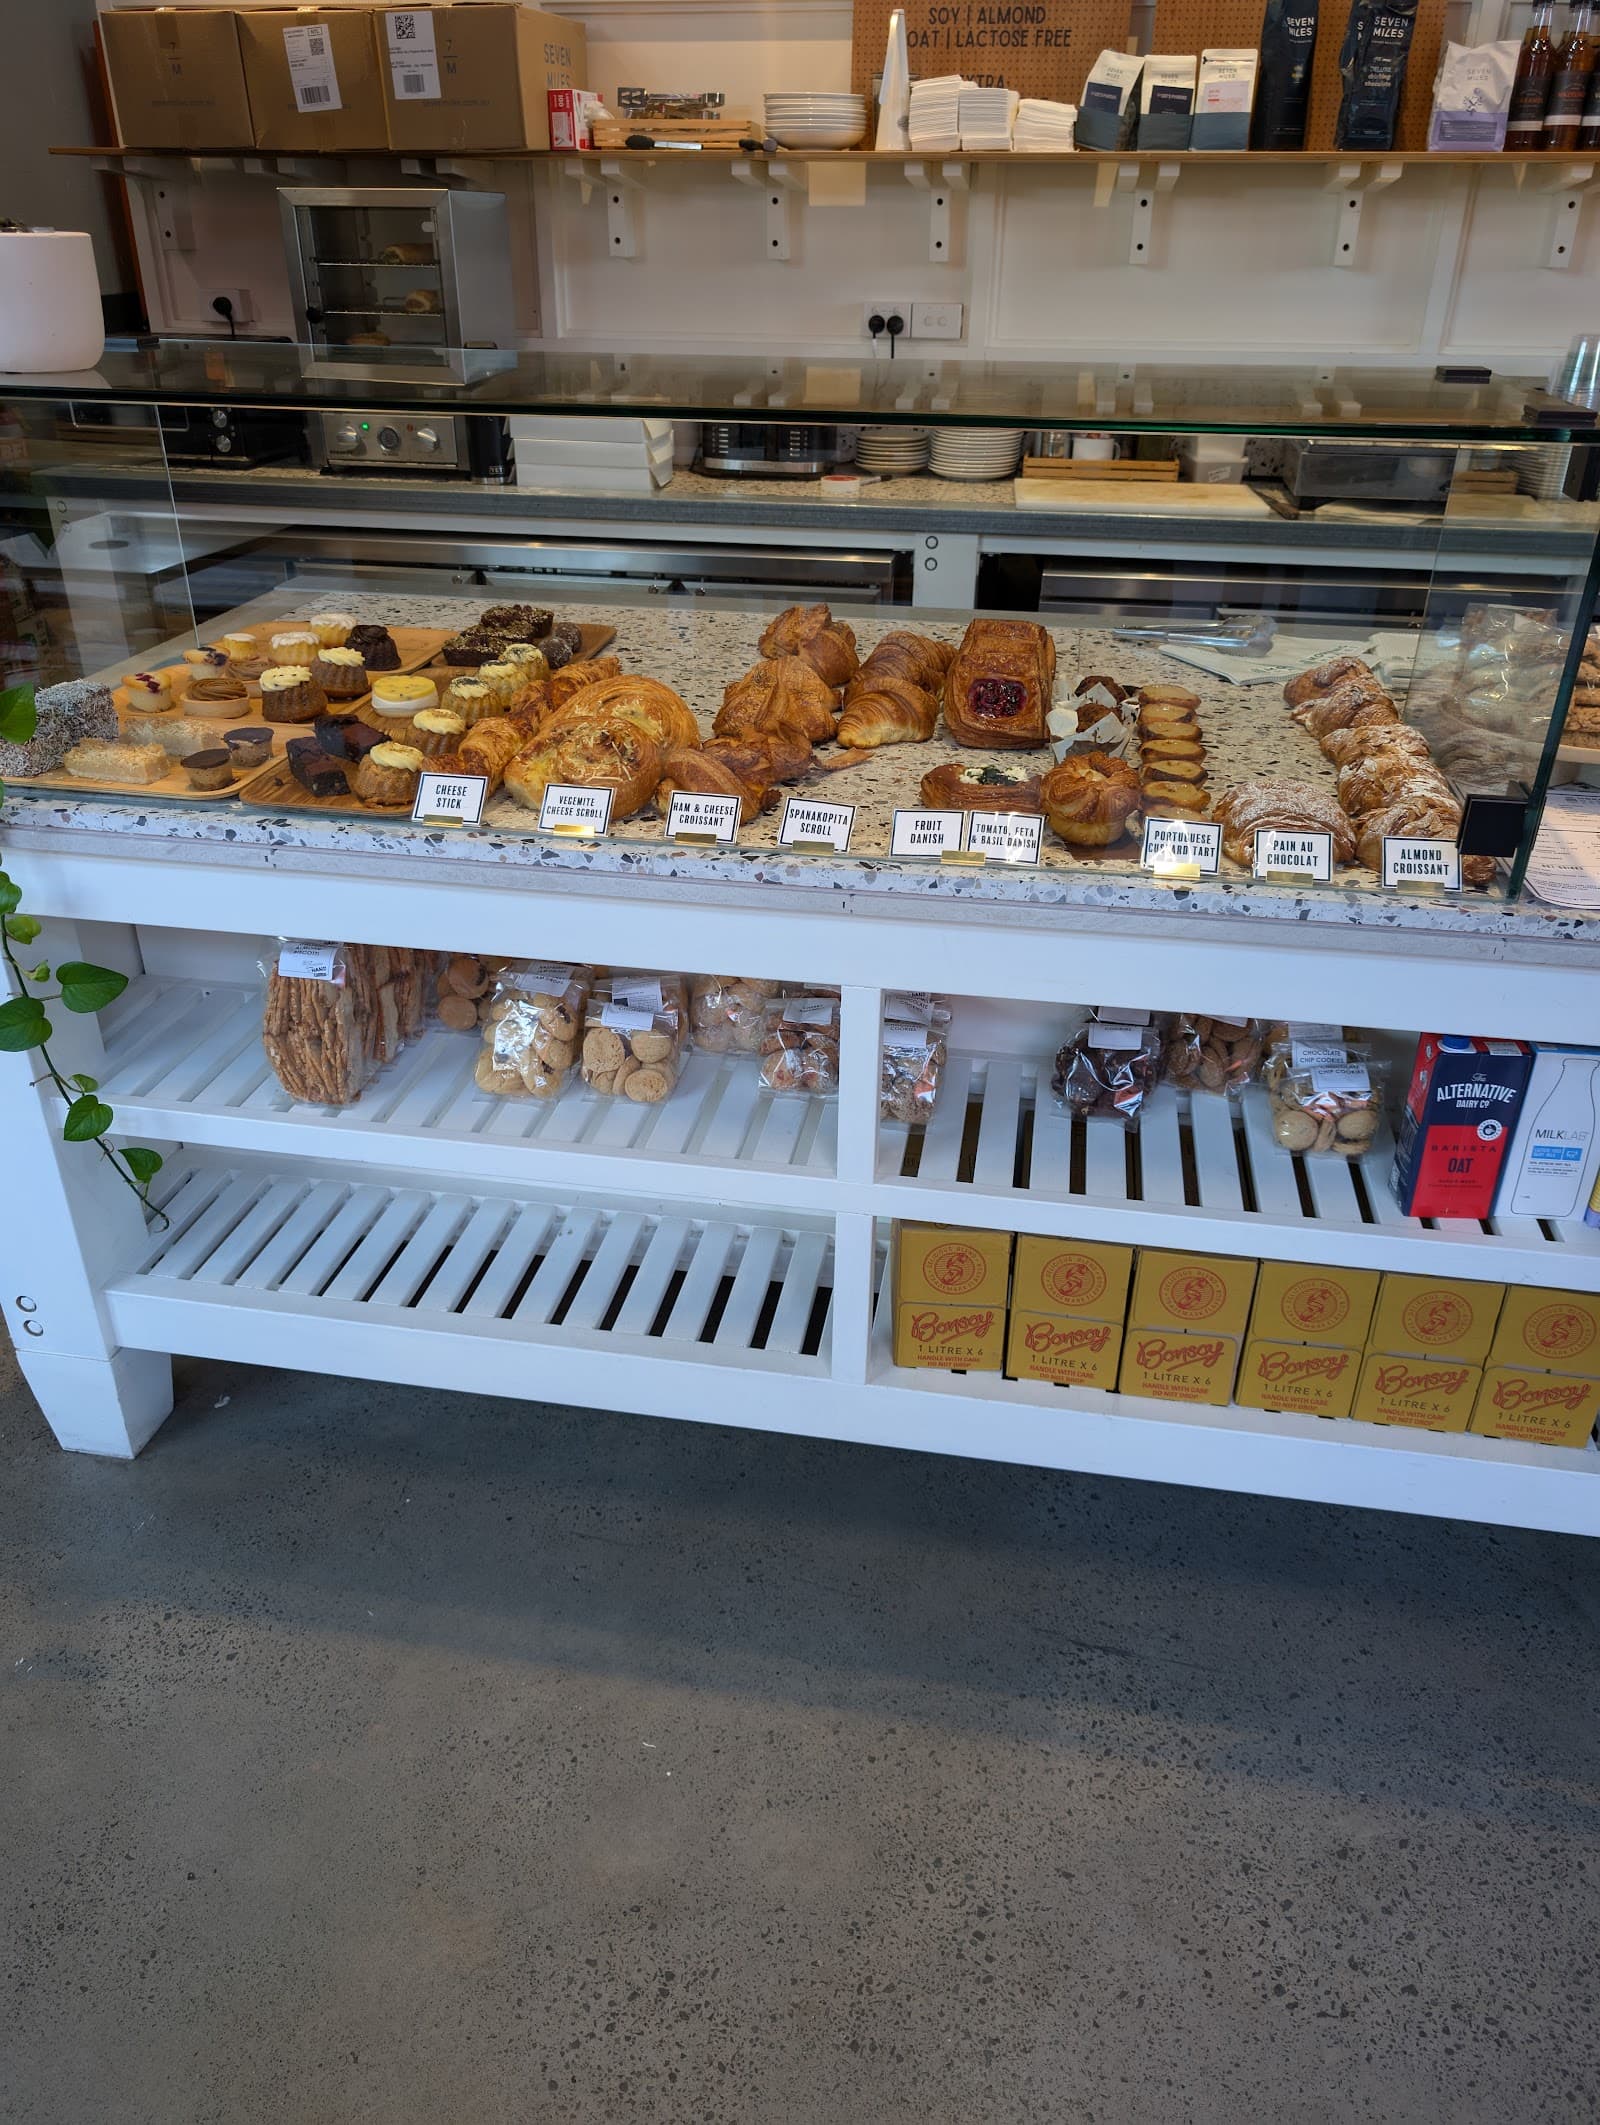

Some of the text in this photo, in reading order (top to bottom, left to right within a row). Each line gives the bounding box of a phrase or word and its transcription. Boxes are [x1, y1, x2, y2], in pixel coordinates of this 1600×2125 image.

[928, 7, 960, 25] SOY
[976, 6, 1046, 25] ALMOND
[1286, 17, 1315, 27] SEVEN
[1374, 16, 1409, 28] SEVEN
[906, 30, 940, 48] OAT
[956, 30, 1029, 48] LACTOSE
[1035, 29, 1072, 48] FREE
[1288, 27, 1313, 37] MILES
[1373, 28, 1405, 39] MILES
[544, 42, 572, 68] SEVEN
[959, 74, 1005, 88] XTRA
[435, 784, 468, 797] CHEESE
[436, 797, 462, 809] STICK
[559, 795, 596, 807] VEGEMITE
[546, 805, 604, 819] CHEESE SCROLL
[673, 802, 735, 816] HAM & CHEESE
[679, 815, 725, 828] CROISSANT
[788, 808, 849, 826] SPANAKOPITA
[799, 822, 832, 837] SCROLL
[914, 820, 943, 832] FRUIT
[1014, 826, 1035, 838] FETA
[910, 833, 945, 845] DANISH
[981, 835, 1004, 846] BASIL
[1007, 837, 1037, 849] DANISH
[1273, 839, 1314, 853] PAIN AU
[1148, 842, 1216, 858] CUSARD TART
[1400, 848, 1442, 861] ALMOND
[1267, 853, 1319, 867] CHOCOLAT
[1393, 862, 1450, 876] CROISSANT
[1302, 1048, 1342, 1057] CHOCOLATE
[1436, 1083, 1517, 1104] ALTERNATIVE
[1455, 1099, 1480, 1109] DAIRY
[1431, 1144, 1497, 1153] BARISTA
[1447, 1157, 1475, 1174] OAT
[911, 1311, 995, 1345] Bonsoy
[1025, 1322, 1112, 1356] Bonsoy
[928, 1346, 962, 1355] LITRE
[967, 1347, 973, 1355] X
[978, 1348, 984, 1356] 6
[1136, 1338, 1225, 1372] Bonsoy
[1032, 1354, 1036, 1362] 1
[1042, 1356, 1076, 1367] LITRE
[1080, 1360, 1087, 1370] X
[1258, 1352, 1349, 1384] Bonsoy
[1153, 1372, 1189, 1383] LITRE
[1193, 1376, 1200, 1384] X
[1204, 1377, 1212, 1385] 6
[1374, 1364, 1470, 1398] Bonsoy
[1274, 1384, 1310, 1395] LITRE
[1326, 1390, 1333, 1398] 6
[1492, 1379, 1592, 1414] Bonsoy
[1380, 1397, 1384, 1406] 1
[1390, 1398, 1427, 1410] LITRE
[1432, 1403, 1440, 1412] X
[1498, 1412, 1503, 1420] 1
[1508, 1414, 1548, 1426] LITRE
[1552, 1418, 1560, 1427] X
